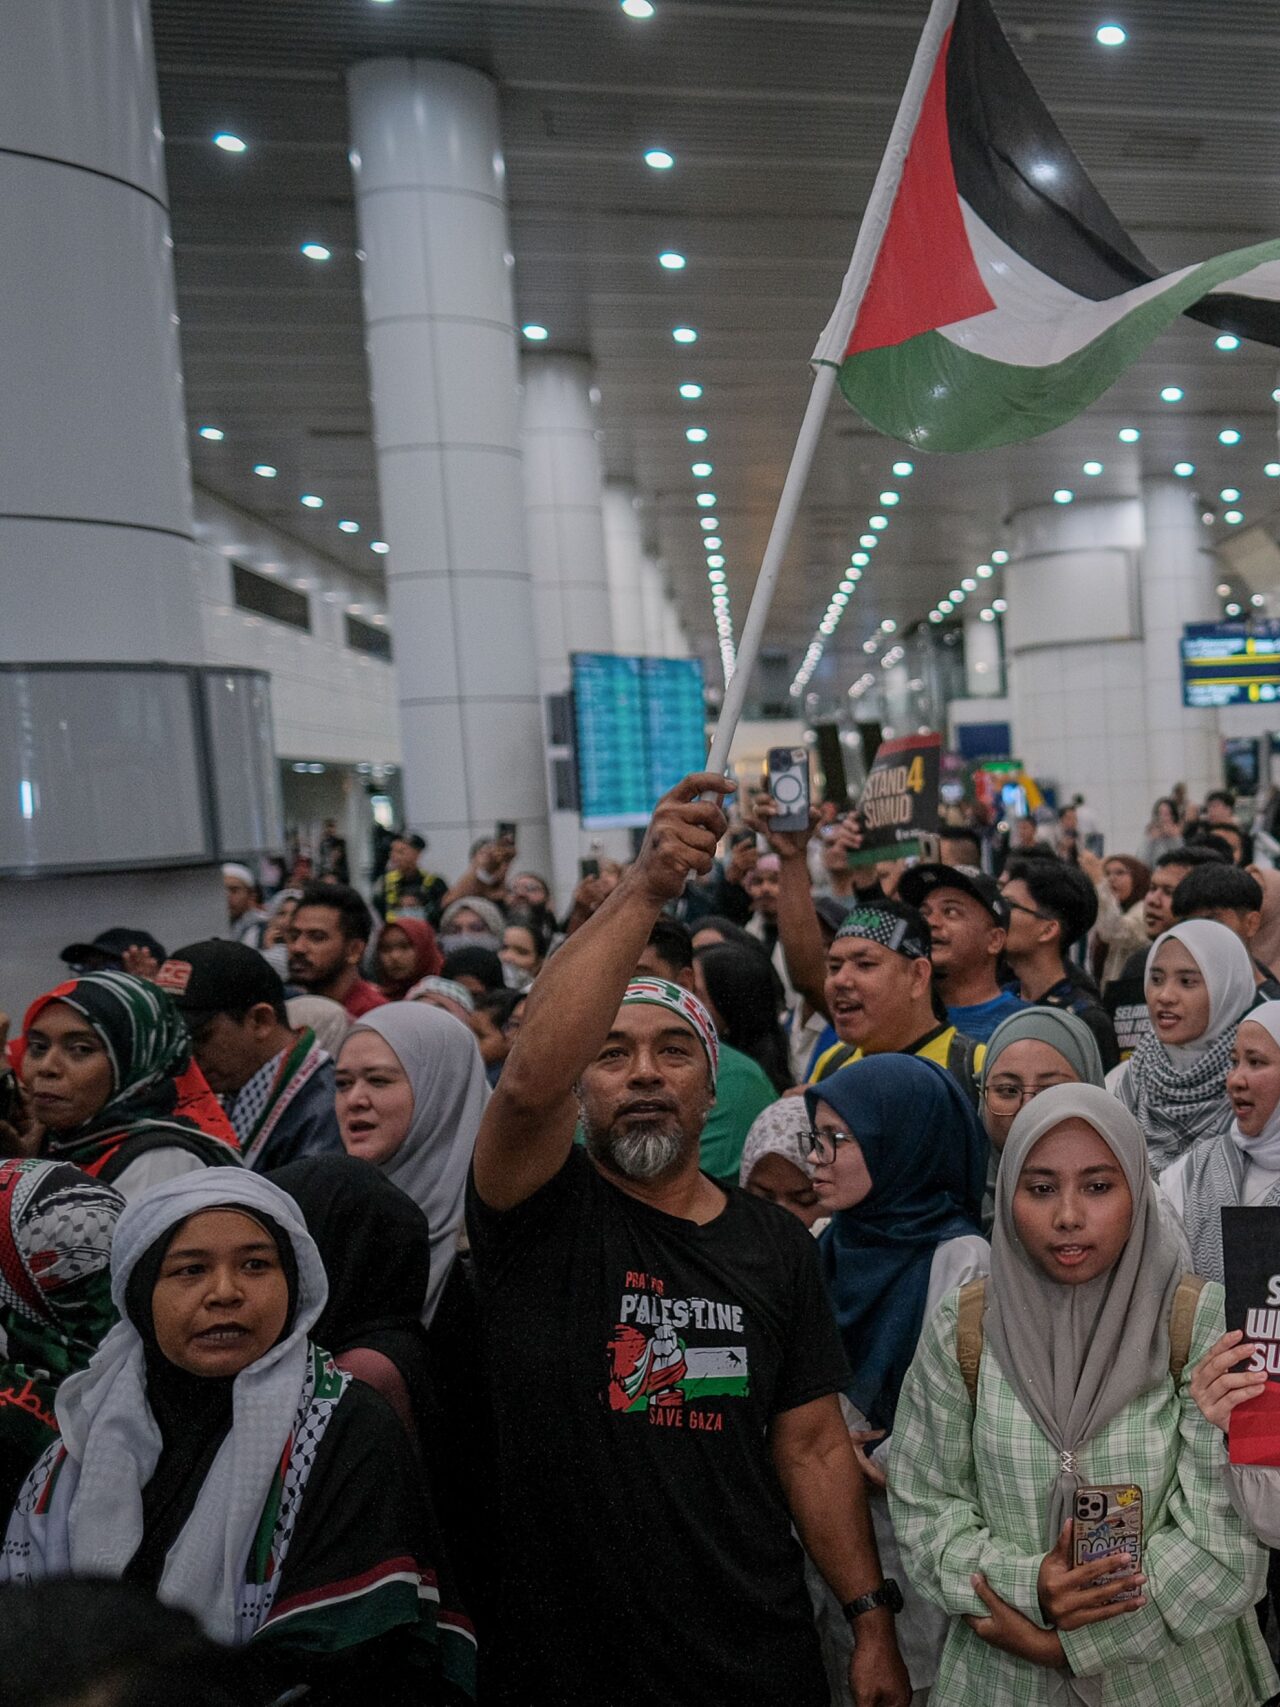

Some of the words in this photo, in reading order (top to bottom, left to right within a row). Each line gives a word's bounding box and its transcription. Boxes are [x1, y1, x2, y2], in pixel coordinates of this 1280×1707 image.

[620, 1294, 744, 1333] PALESTINE
[650, 1407, 683, 1428] SAVE
[689, 1410, 723, 1431] GAZA
